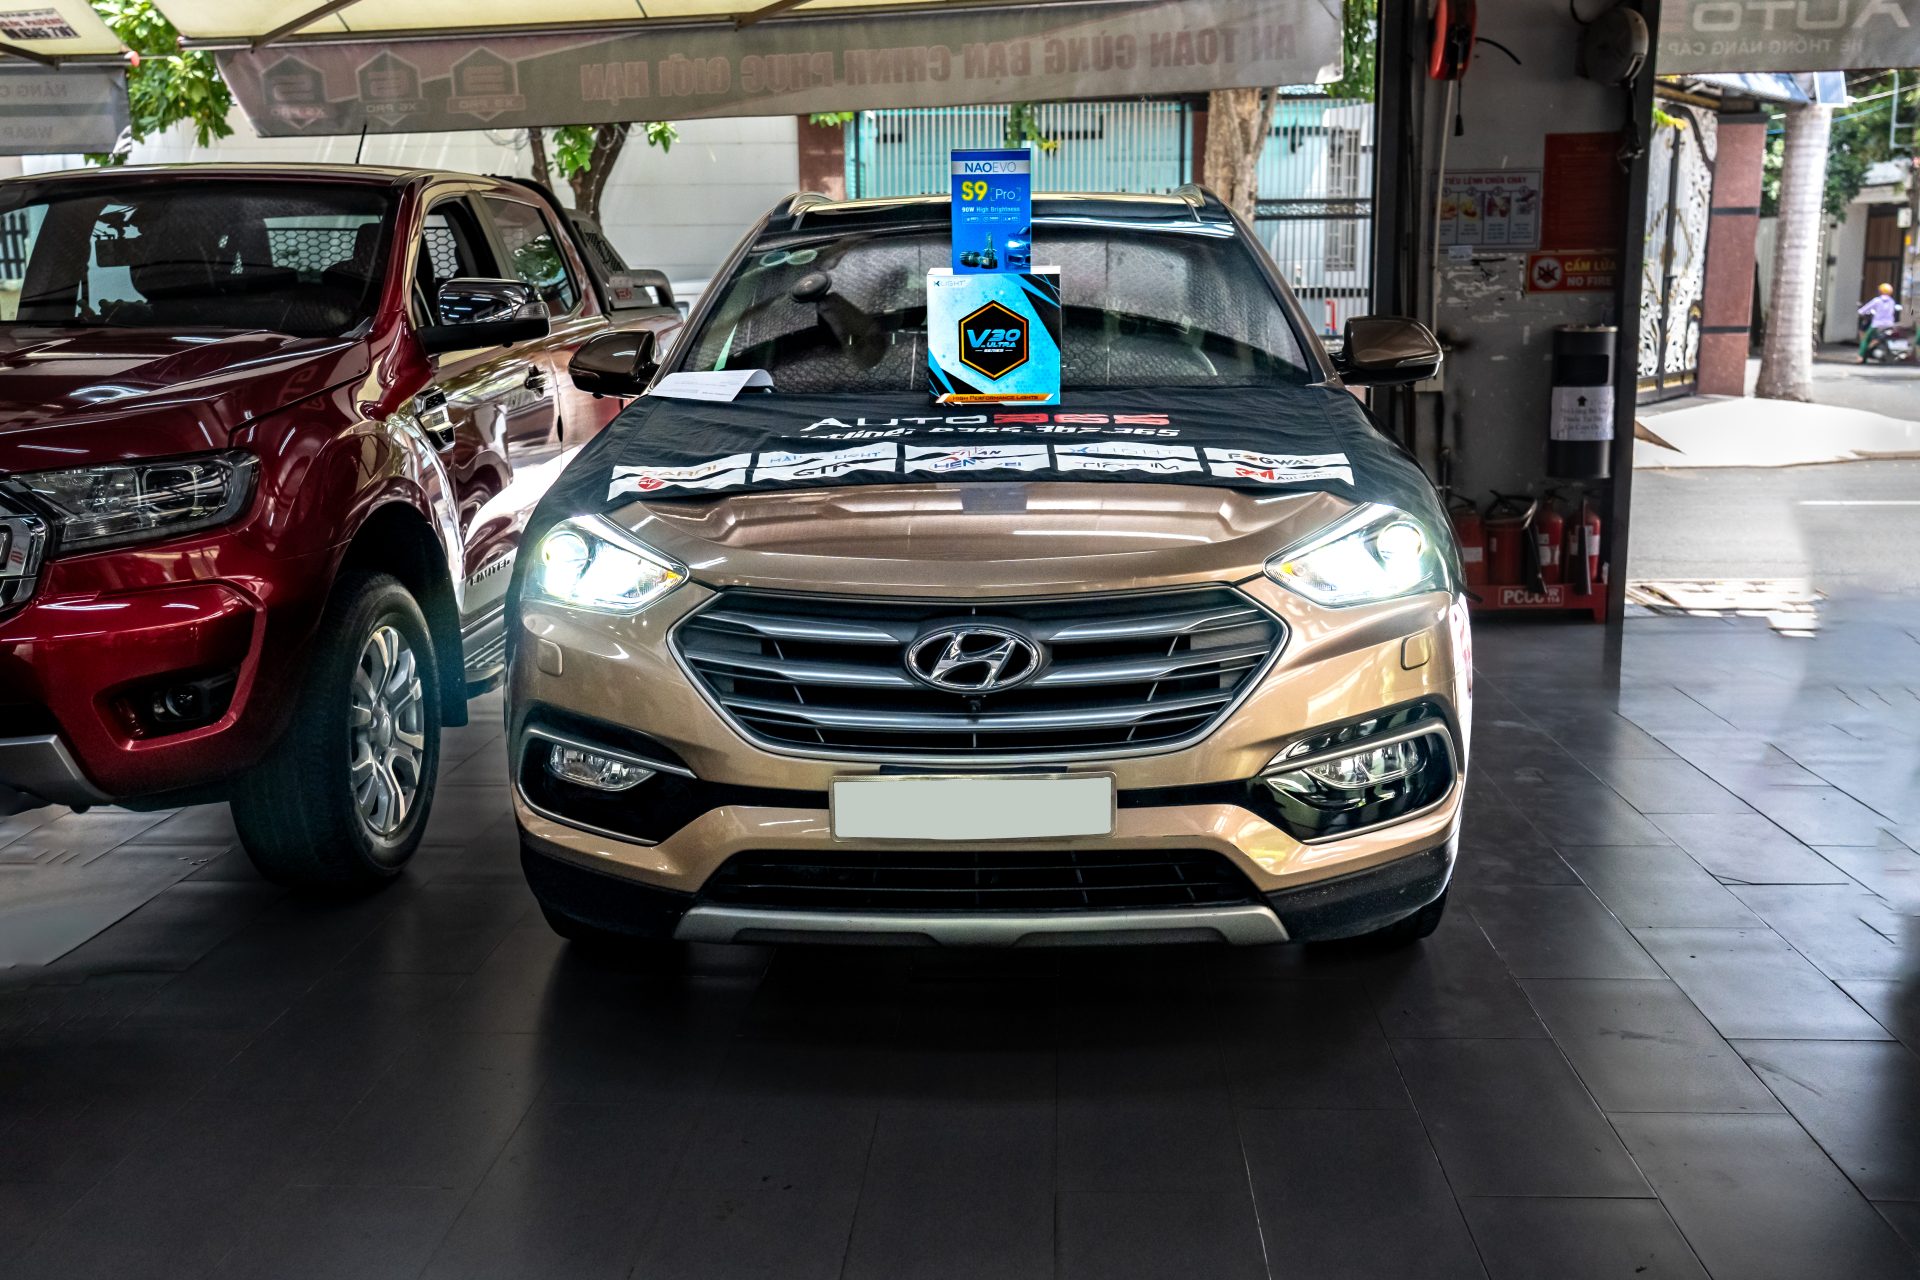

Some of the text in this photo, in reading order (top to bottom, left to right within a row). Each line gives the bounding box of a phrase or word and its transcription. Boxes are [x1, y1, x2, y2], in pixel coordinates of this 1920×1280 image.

[964, 161, 1017, 174] NAOEVO
[961, 181, 1016, 202] S9 Pro
[1567, 275, 1612, 287] NO FIRE
[967, 329, 1021, 348] V30
